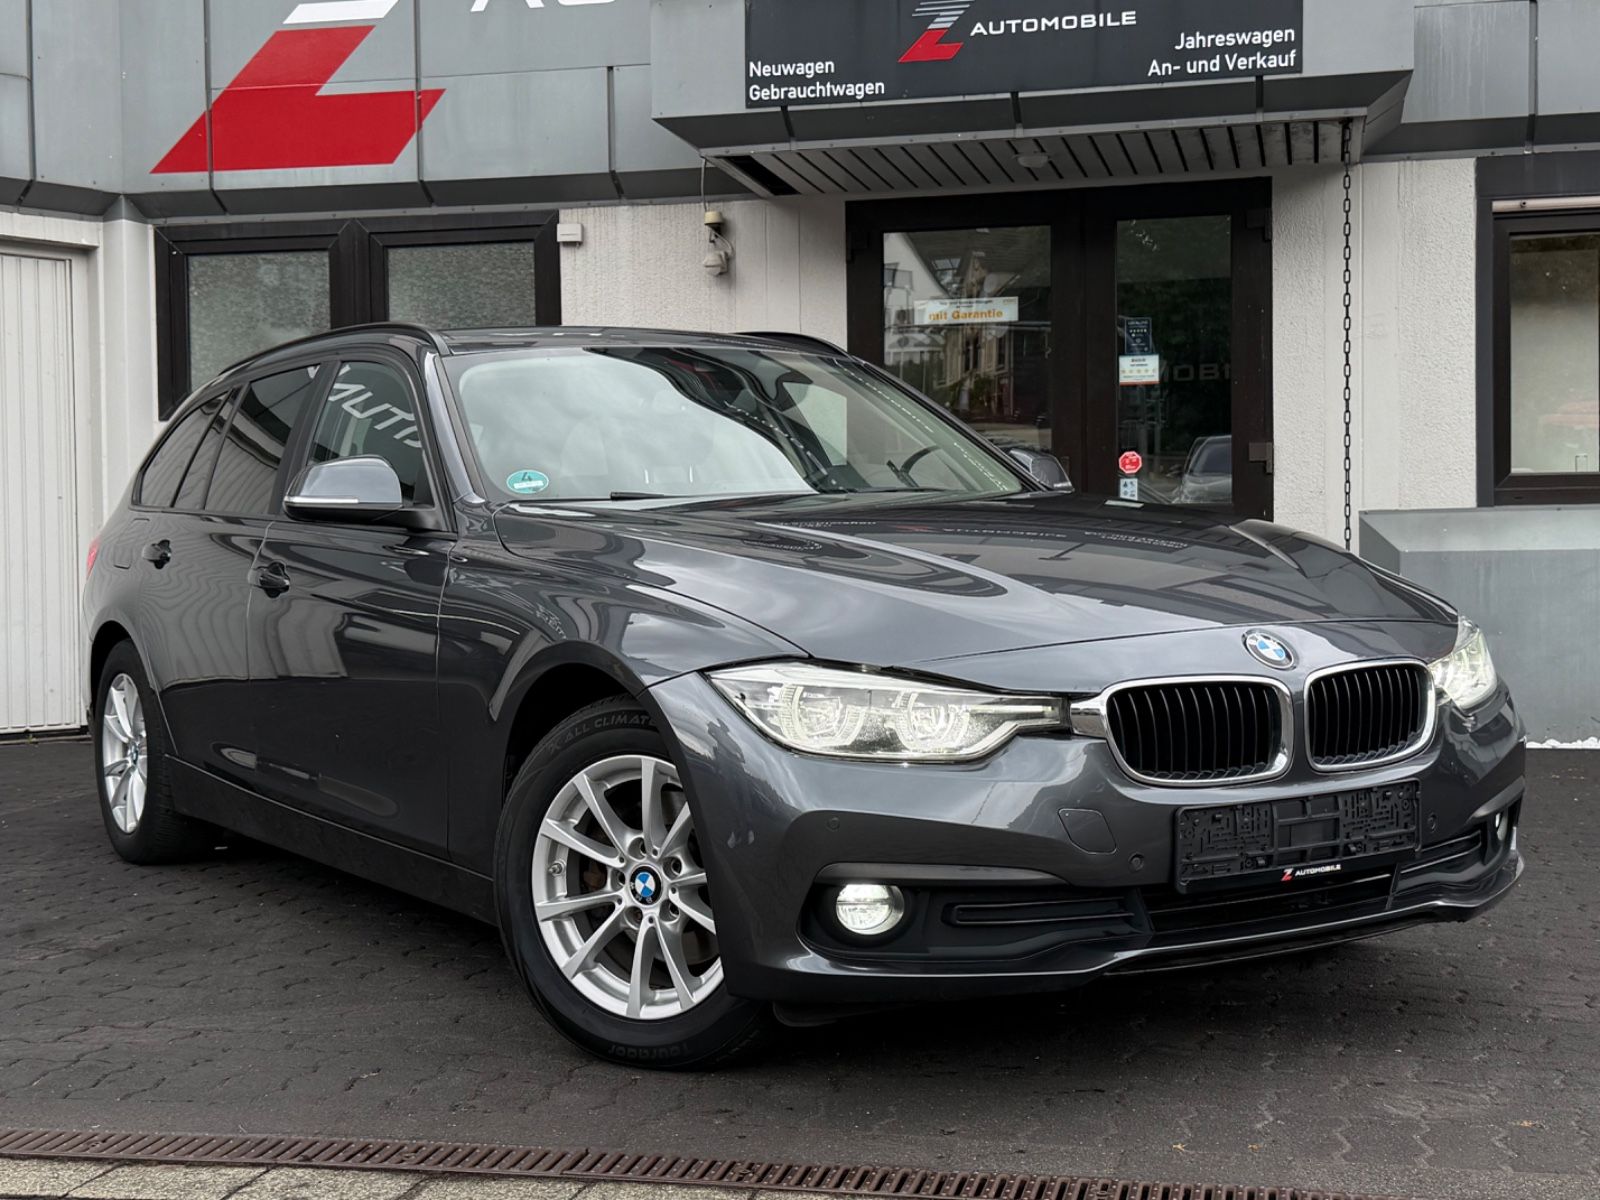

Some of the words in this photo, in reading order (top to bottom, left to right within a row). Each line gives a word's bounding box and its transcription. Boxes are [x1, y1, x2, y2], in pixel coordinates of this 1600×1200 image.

[969, 10, 1137, 37] AUTOMOBILE
[1174, 28, 1296, 50] Jahreswagen
[748, 60, 835, 78] Neuwagen
[1147, 58, 1181, 76] An-
[1186, 54, 1221, 74] und
[1224, 49, 1298, 71] Verkauf
[748, 81, 886, 101] Gebrauchtwagen
[951, 308, 1004, 320] Garantie
[1295, 864, 1341, 876] AUTOMOBILE
